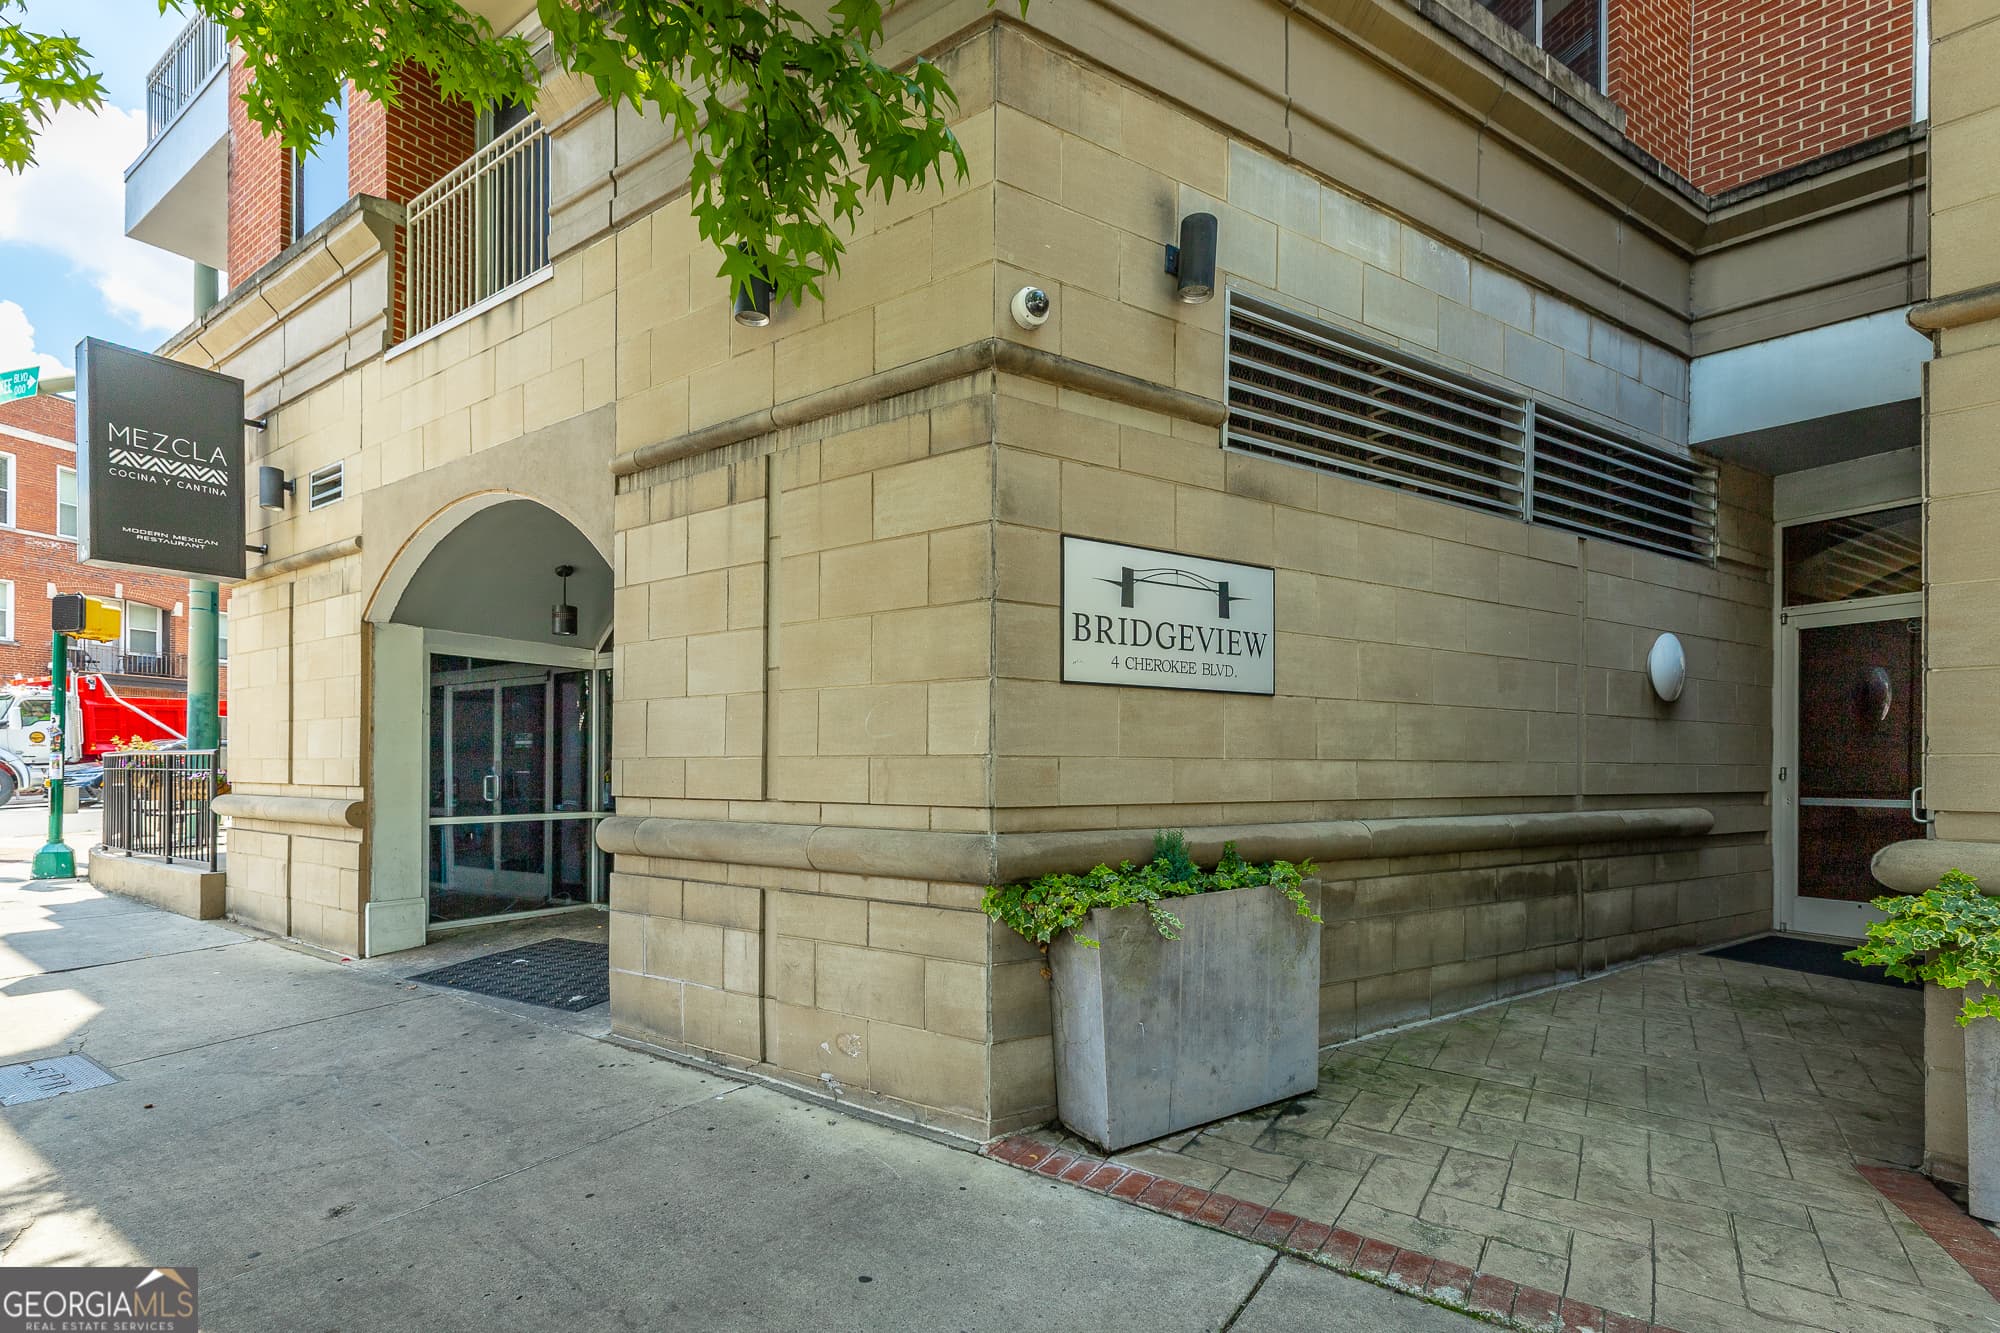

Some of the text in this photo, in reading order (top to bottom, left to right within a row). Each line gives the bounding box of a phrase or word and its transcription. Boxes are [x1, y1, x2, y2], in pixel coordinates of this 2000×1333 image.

[13, 372, 28, 384] BLVD
[108, 422, 228, 467] MEZCLA
[109, 467, 227, 497] COCINA Y CANTINA
[122, 526, 219, 546] MODERN MEXICAN
[136, 534, 206, 549] RESTAURANT
[1072, 612, 1268, 659] BRIDGEVIEW
[1111, 656, 1238, 678] 4 CHEROKEE BLVD.
